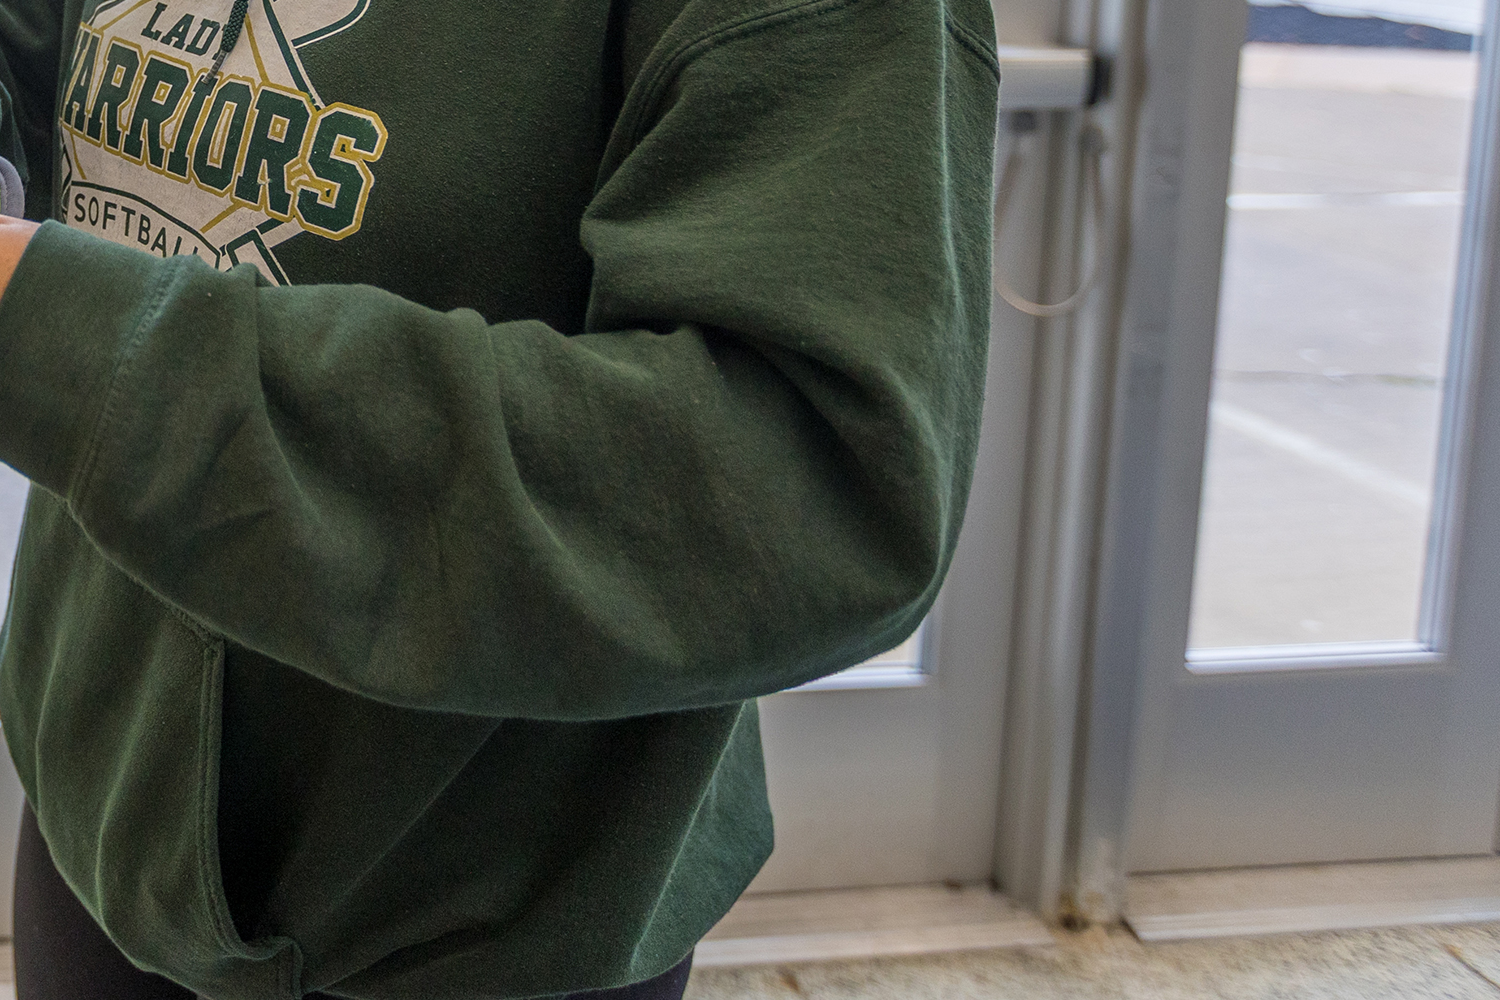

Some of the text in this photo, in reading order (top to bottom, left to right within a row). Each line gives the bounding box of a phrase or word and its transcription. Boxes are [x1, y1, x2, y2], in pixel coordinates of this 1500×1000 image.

[141, 2, 226, 61] LAD
[60, 21, 388, 241] ARRIORS
[74, 192, 199, 257] SOFTBA
